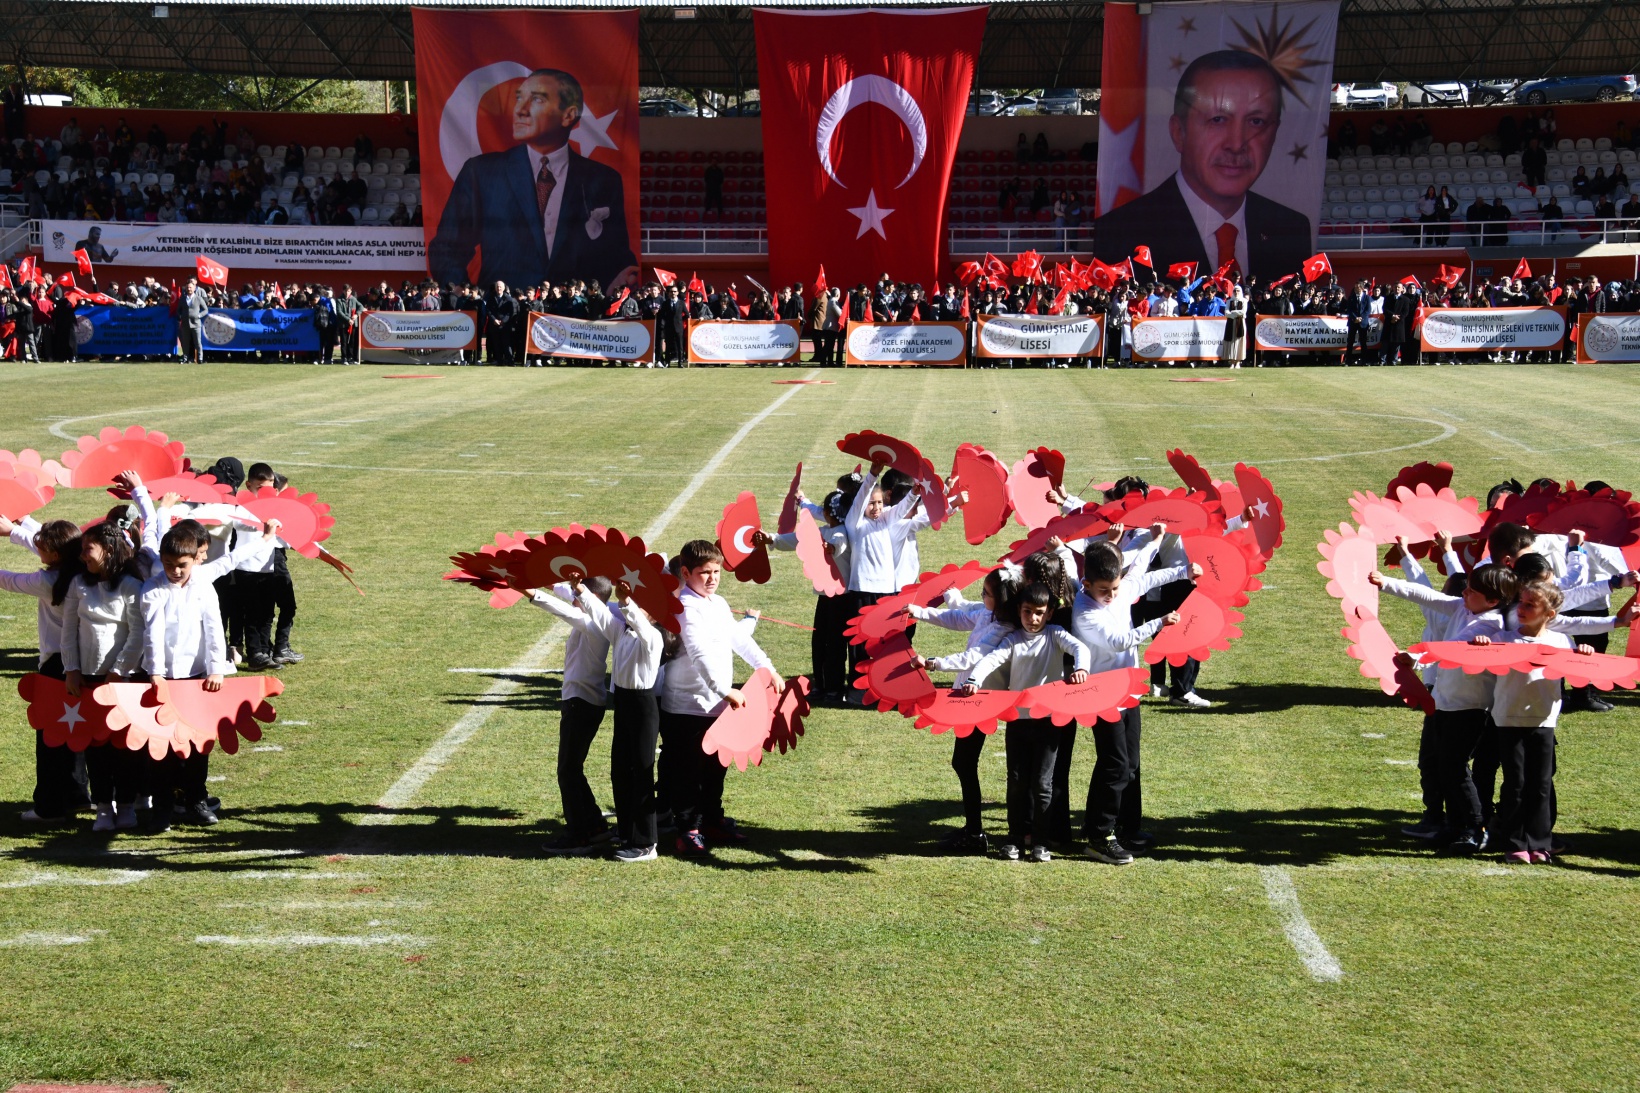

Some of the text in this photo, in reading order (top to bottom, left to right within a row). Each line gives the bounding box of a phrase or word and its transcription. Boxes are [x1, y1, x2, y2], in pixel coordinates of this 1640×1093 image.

[156, 235, 204, 244] YETENEĞİN
[220, 236, 261, 245] KALBİNLE
[264, 237, 282, 246] BİZE
[285, 238, 334, 247] BIRAKTIĞIN
[336, 238, 363, 246] MİRAS
[204, 246, 252, 255] KÖŞESİNDE
[376, 248, 396, 256] SENİ
[1462, 315, 1504, 323] GÜMÜŞHANE
[571, 324, 608, 332] GÜMÜŞHANE
[1021, 323, 1088, 335] GÜMÜŞHANE
[1478, 324, 1494, 332] SİNA
[1496, 324, 1524, 332] MESLEKİ
[1535, 324, 1560, 332] TEKNİK
[570, 342, 591, 350] İMAM
[615, 346, 636, 354] LİSESİ
[1021, 340, 1050, 350] LİSESİ
